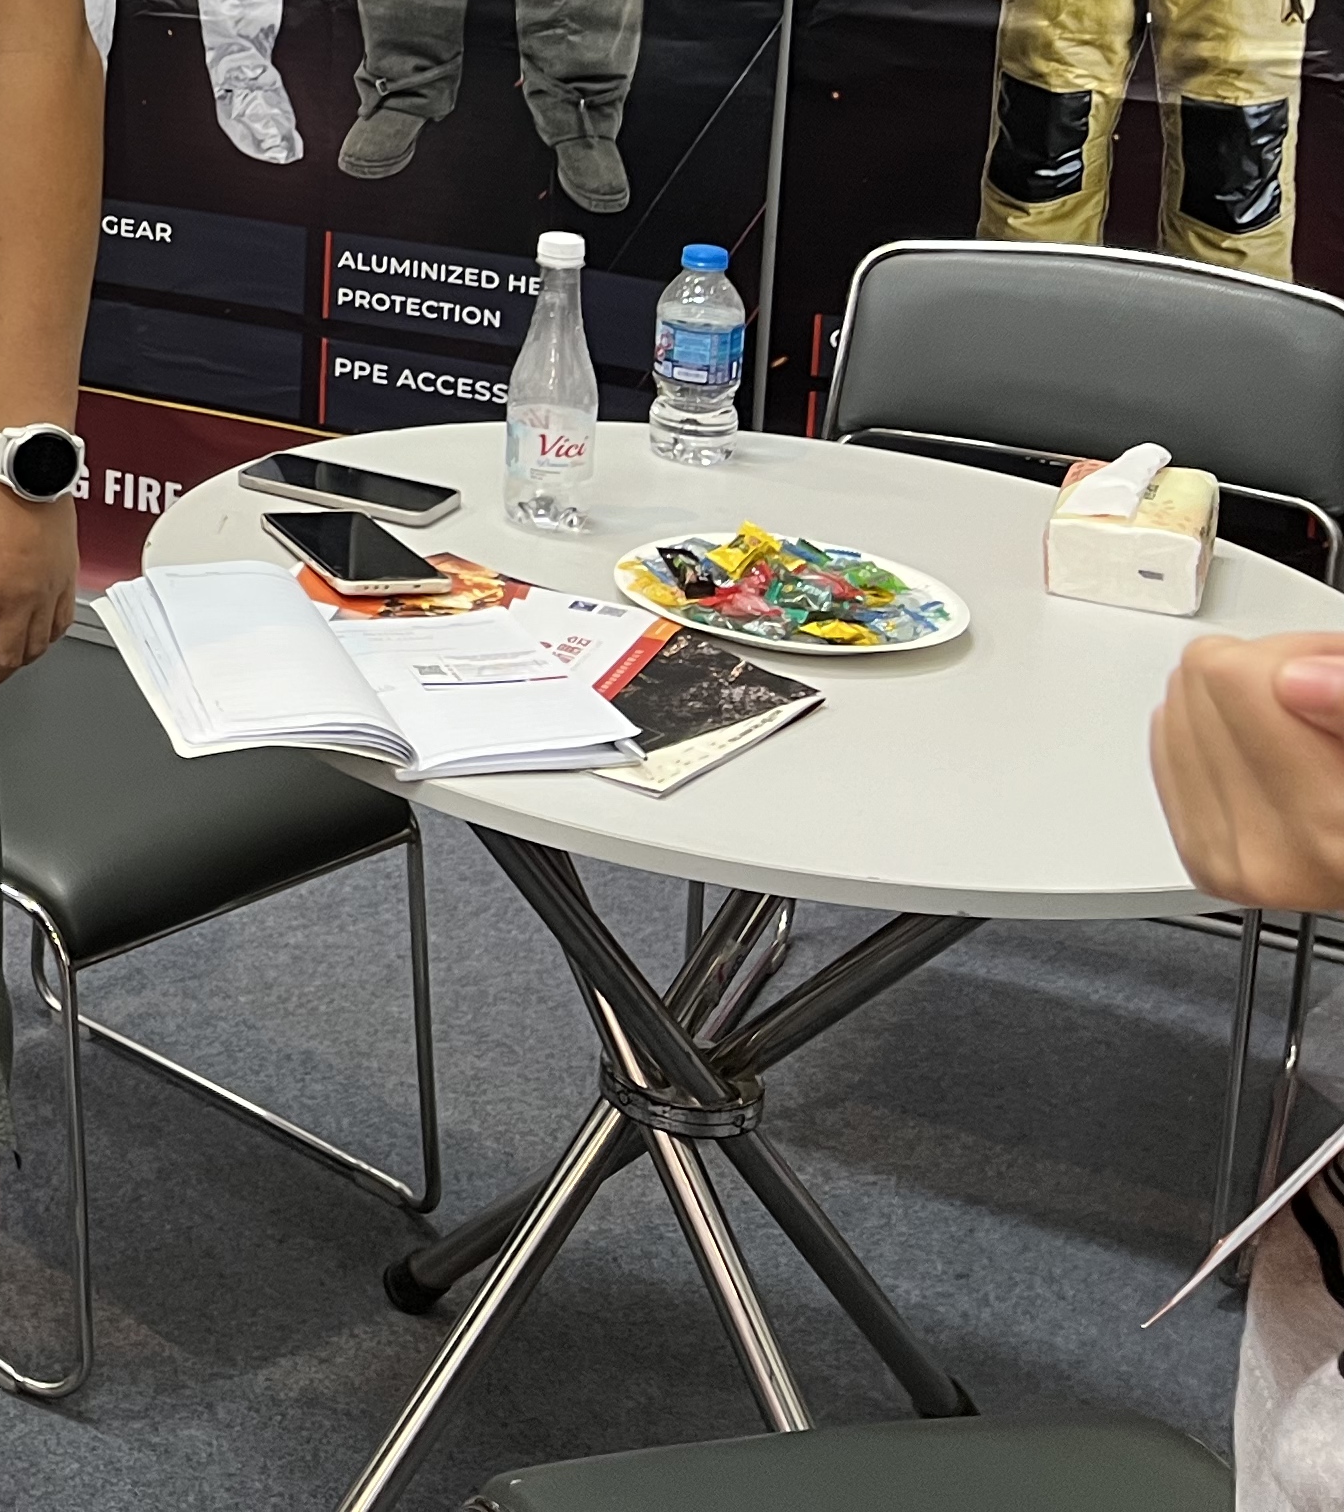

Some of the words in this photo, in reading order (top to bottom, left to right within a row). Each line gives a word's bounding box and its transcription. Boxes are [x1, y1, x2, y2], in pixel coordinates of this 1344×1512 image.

[102, 216, 171, 242] GEAR
[338, 251, 499, 288] ALUMINIZED
[508, 273, 542, 295] HE
[338, 288, 500, 327] PROTECTION
[335, 358, 388, 384] PPE
[396, 368, 509, 404] ACCESS
[539, 434, 589, 458] Vici
